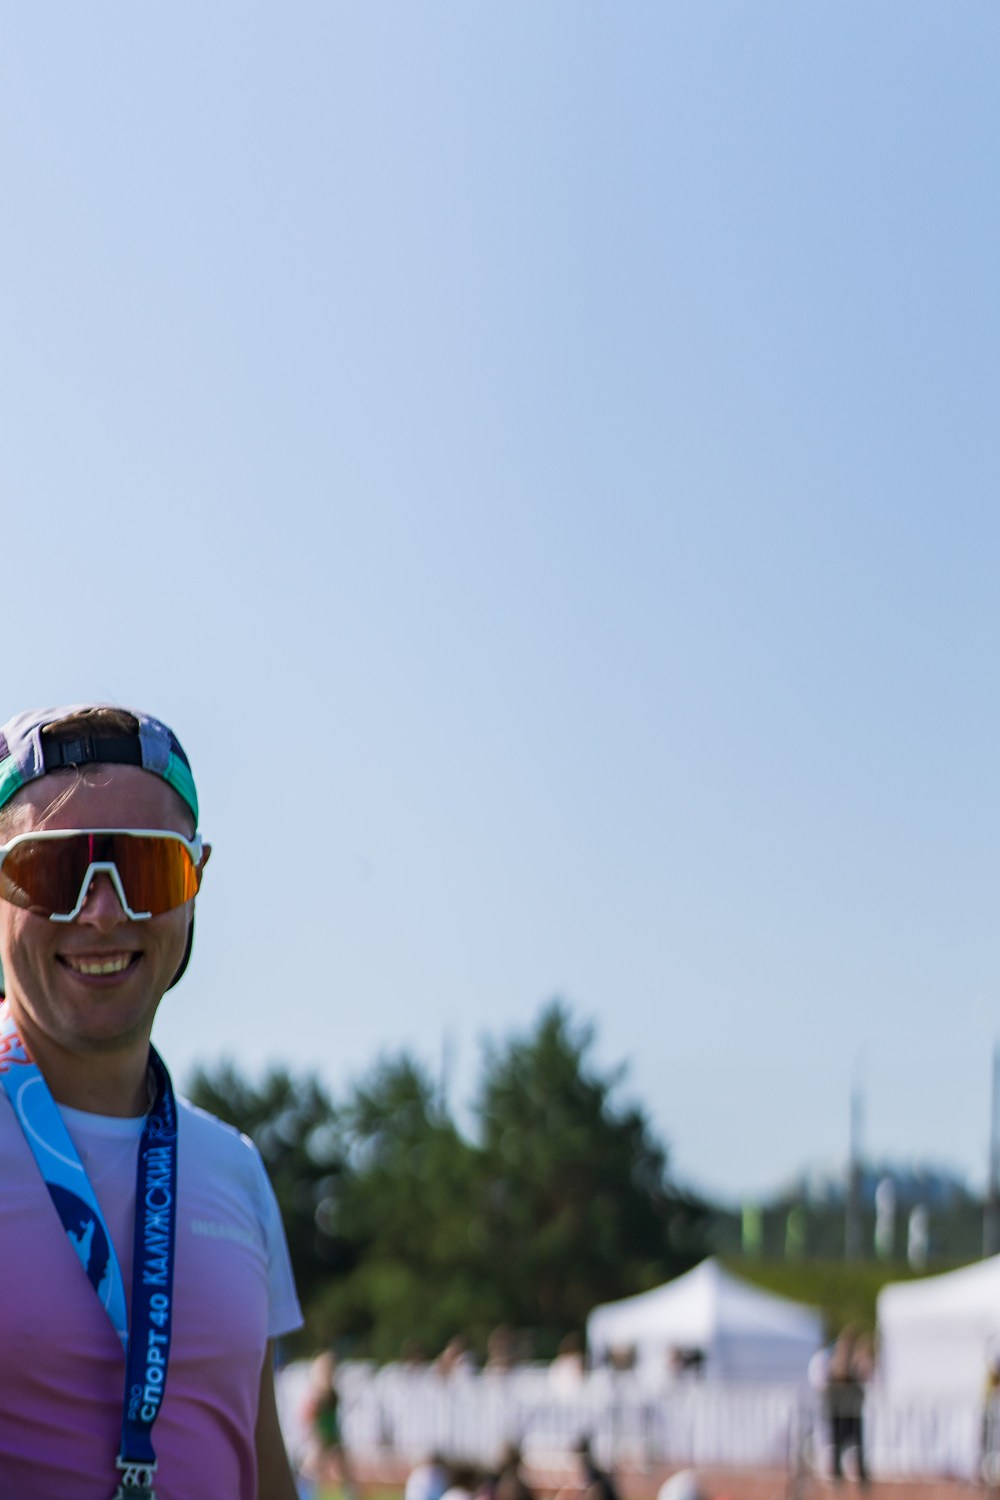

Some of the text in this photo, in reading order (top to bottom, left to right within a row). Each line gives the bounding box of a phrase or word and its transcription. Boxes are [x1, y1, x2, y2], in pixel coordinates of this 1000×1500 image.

[142, 1146, 172, 1287] КАЛУЖСКИЙ
[148, 1293, 170, 1328] 40
[140, 1329, 169, 1423] СПОРТ
